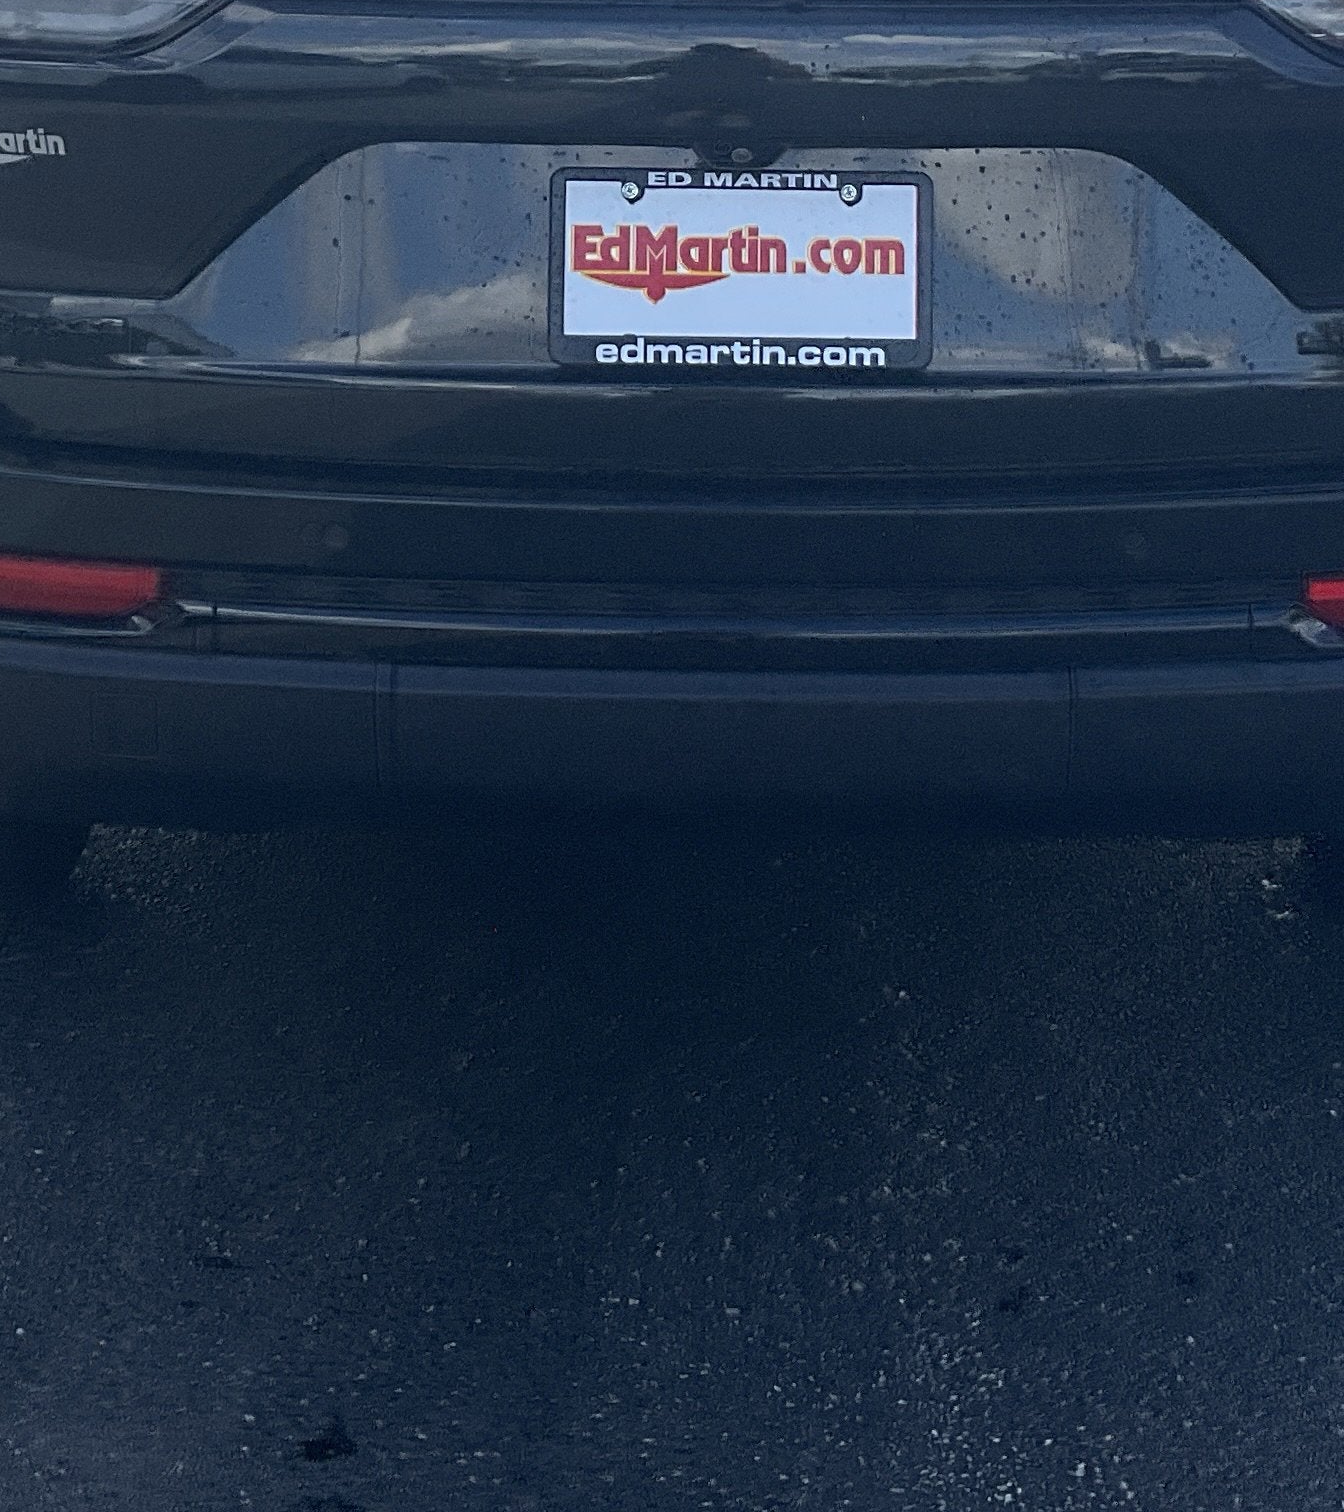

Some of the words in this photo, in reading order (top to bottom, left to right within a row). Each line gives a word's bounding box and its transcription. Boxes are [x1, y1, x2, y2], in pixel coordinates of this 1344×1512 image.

[647, 171, 692, 187] ED
[703, 172, 839, 189] MARTIN
[570, 224, 905, 288] EdMartin.com
[595, 338, 887, 367] edmartin.com
